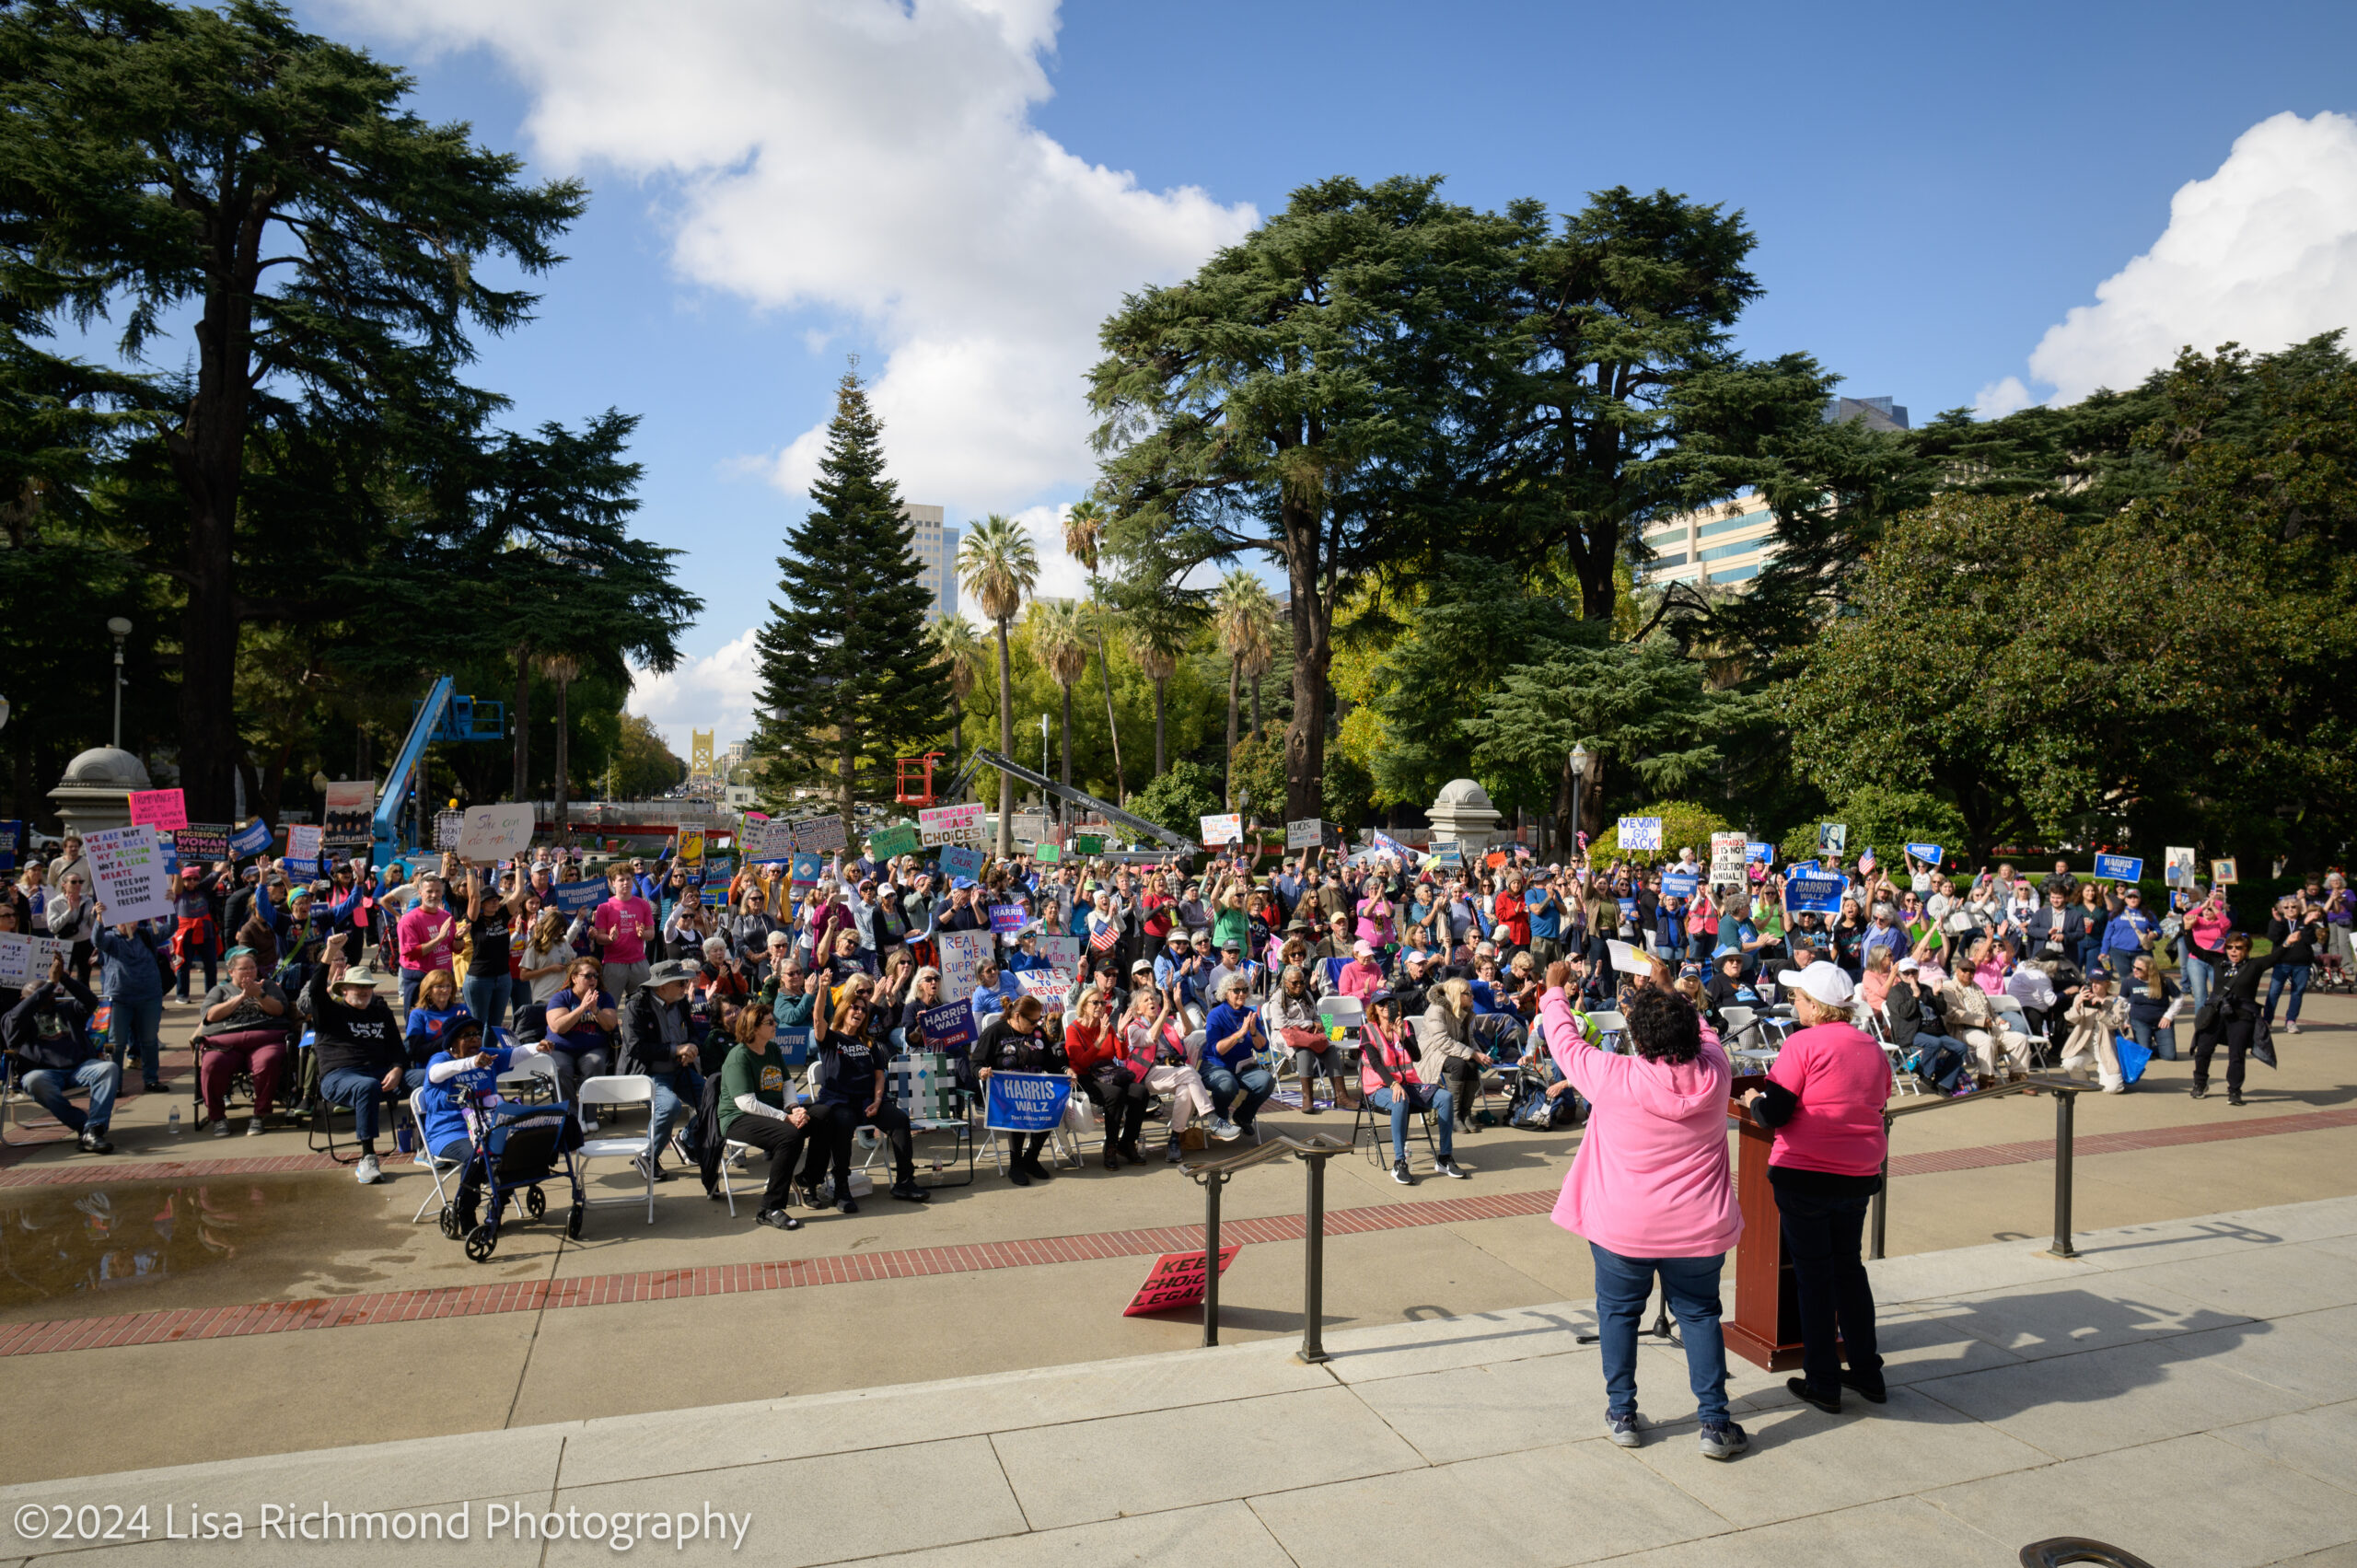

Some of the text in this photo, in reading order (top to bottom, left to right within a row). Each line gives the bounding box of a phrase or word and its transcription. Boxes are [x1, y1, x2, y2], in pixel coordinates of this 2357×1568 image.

[921, 806, 983, 821] DEMOCRACY
[502, 819, 520, 829] can
[812, 821, 827, 830] LOVE
[828, 819, 842, 827] WINS
[938, 817, 974, 830] MEANS
[1132, 819, 1160, 835] RENT CAT
[85, 829, 141, 843] WE ARE NOT
[232, 825, 267, 847] REPRODUCTIVE
[468, 832, 483, 846] do
[872, 830, 890, 844] OUR
[1633, 828, 1649, 839] GO
[177, 837, 227, 847] WOMAN
[242, 834, 267, 853] FREEDOM
[741, 836, 761, 845] BACK
[1622, 836, 1661, 850] BACK!
[1712, 839, 1746, 848] ANDMAID'S
[90, 842, 120, 853] GOING
[882, 839, 915, 857] KAMALA
[1431, 844, 1459, 853] MORSE
[1721, 846, 1728, 855] IS
[1730, 846, 1747, 855] NOT
[1746, 843, 1766, 854] ARRIS
[1911, 845, 1936, 854] HARRIS
[97, 847, 151, 862] MY DECISION
[98, 862, 115, 871] NOT
[118, 860, 123, 868] A
[292, 861, 319, 873] HARRI
[712, 860, 730, 872] VOTE
[951, 857, 973, 870] OUR
[2104, 857, 2133, 869] HARRIS
[100, 869, 134, 881] DEBATE
[1805, 869, 1840, 880] HARRIS
[113, 876, 150, 889] FREEDOM
[1663, 877, 1697, 887] REPRODUCTIVE
[1669, 884, 1691, 892] FREEDOM
[1795, 880, 1833, 894] HARRIS
[115, 885, 149, 898] FREEDOM
[558, 882, 606, 898] REPRODUCTIVE
[117, 894, 151, 907] FREEDOM
[568, 892, 598, 904] FREEDOM
[993, 908, 1024, 918] HARRIS
[427, 924, 439, 933] WE
[41, 940, 61, 948] FREE
[946, 935, 980, 950] REAL
[963, 947, 987, 959] MEN
[1070, 952, 1076, 962] is
[945, 960, 976, 973] SUPPO
[1025, 969, 1062, 981] VOTE
[952, 985, 976, 997] RIGH
[1027, 984, 1072, 997] PREVENT
[924, 1004, 968, 1028] HARRIS
[935, 1016, 962, 1031] WALZ
[946, 1033, 965, 1044] 2024
[455, 1072, 489, 1083] WE ARE
[468, 1081, 479, 1090] OT
[1004, 1079, 1055, 1100] HARRIS
[1014, 1100, 1050, 1112] WALZ
[1132, 1285, 1206, 1307] LEGAL
